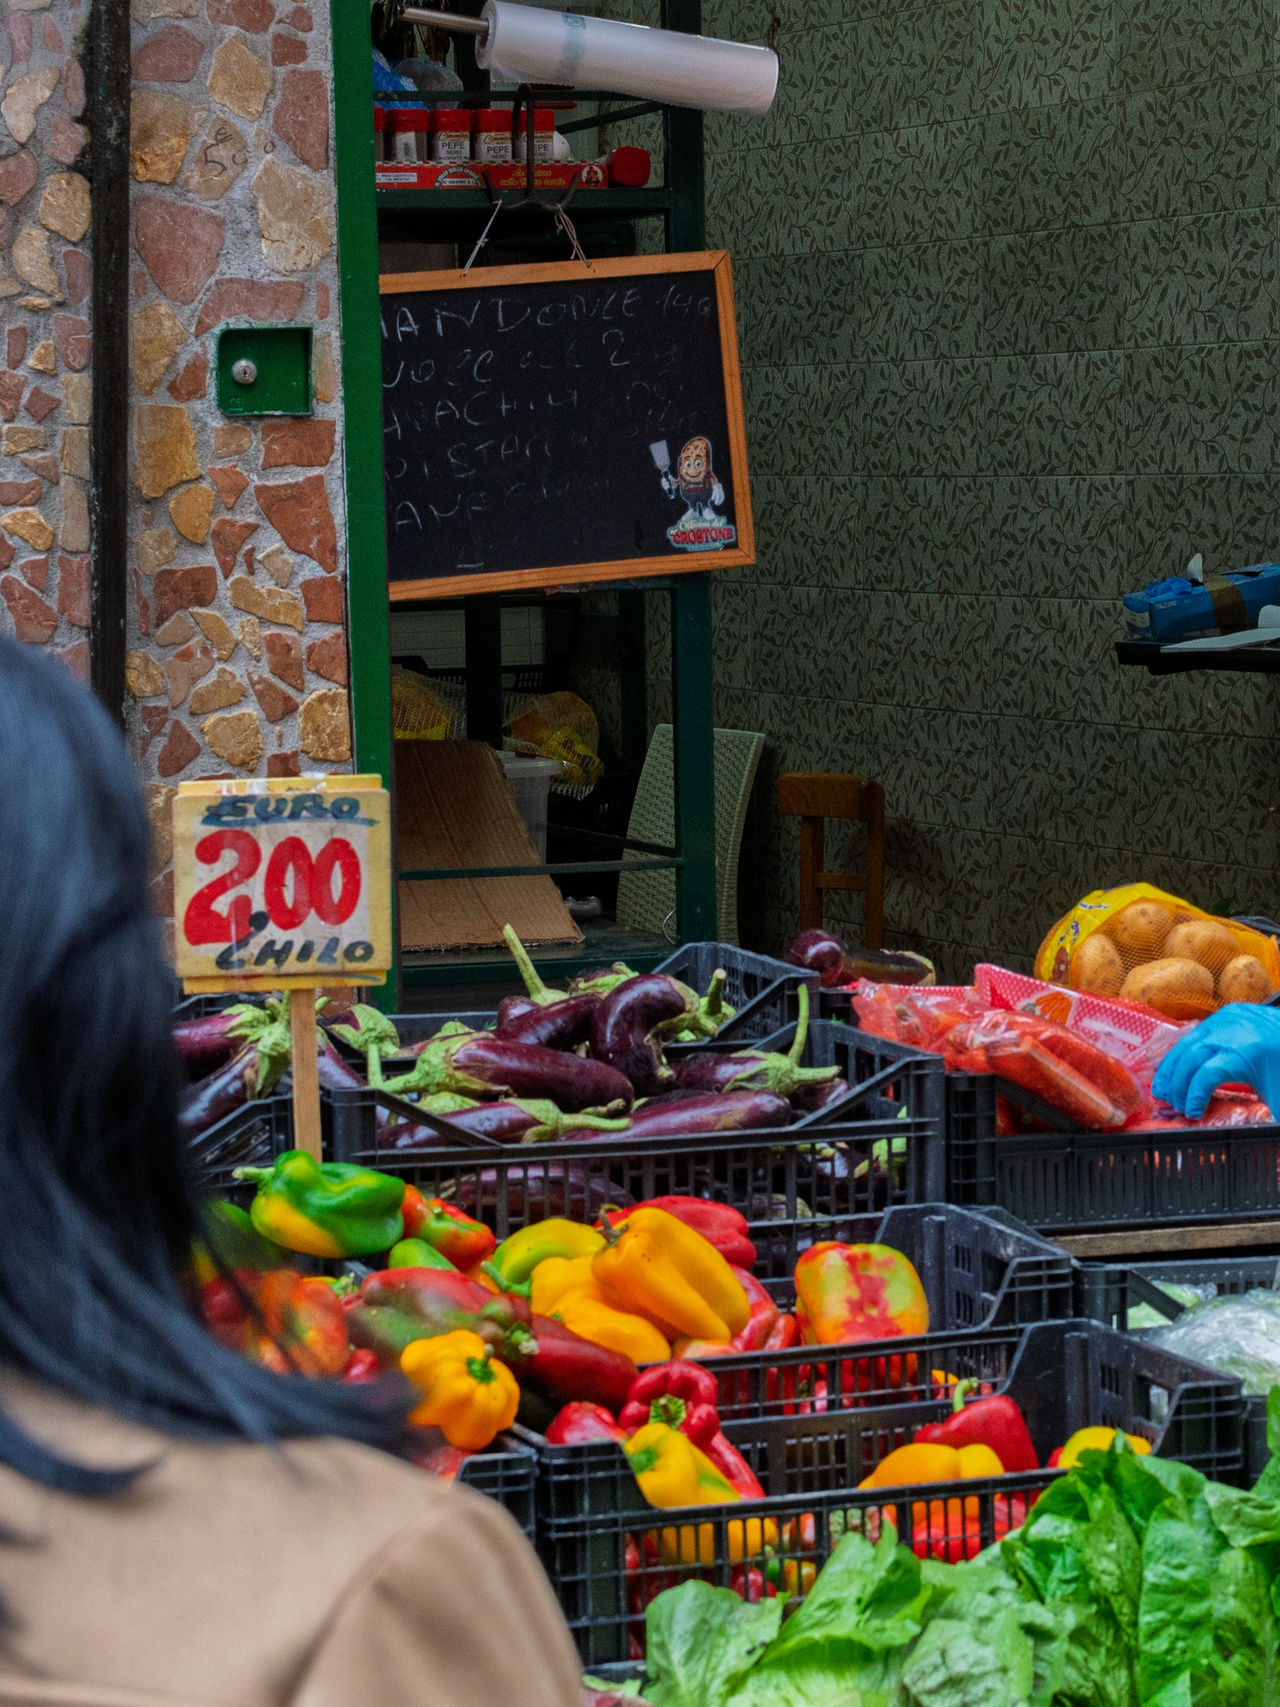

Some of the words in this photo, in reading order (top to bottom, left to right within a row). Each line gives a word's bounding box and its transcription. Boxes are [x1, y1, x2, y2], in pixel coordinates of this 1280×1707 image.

[441, 141, 465, 149] PEPE
[486, 145, 511, 154] PEPE
[534, 143, 549, 151] EPE
[205, 793, 361, 822] EURO
[215, 936, 375, 970] CHILO
